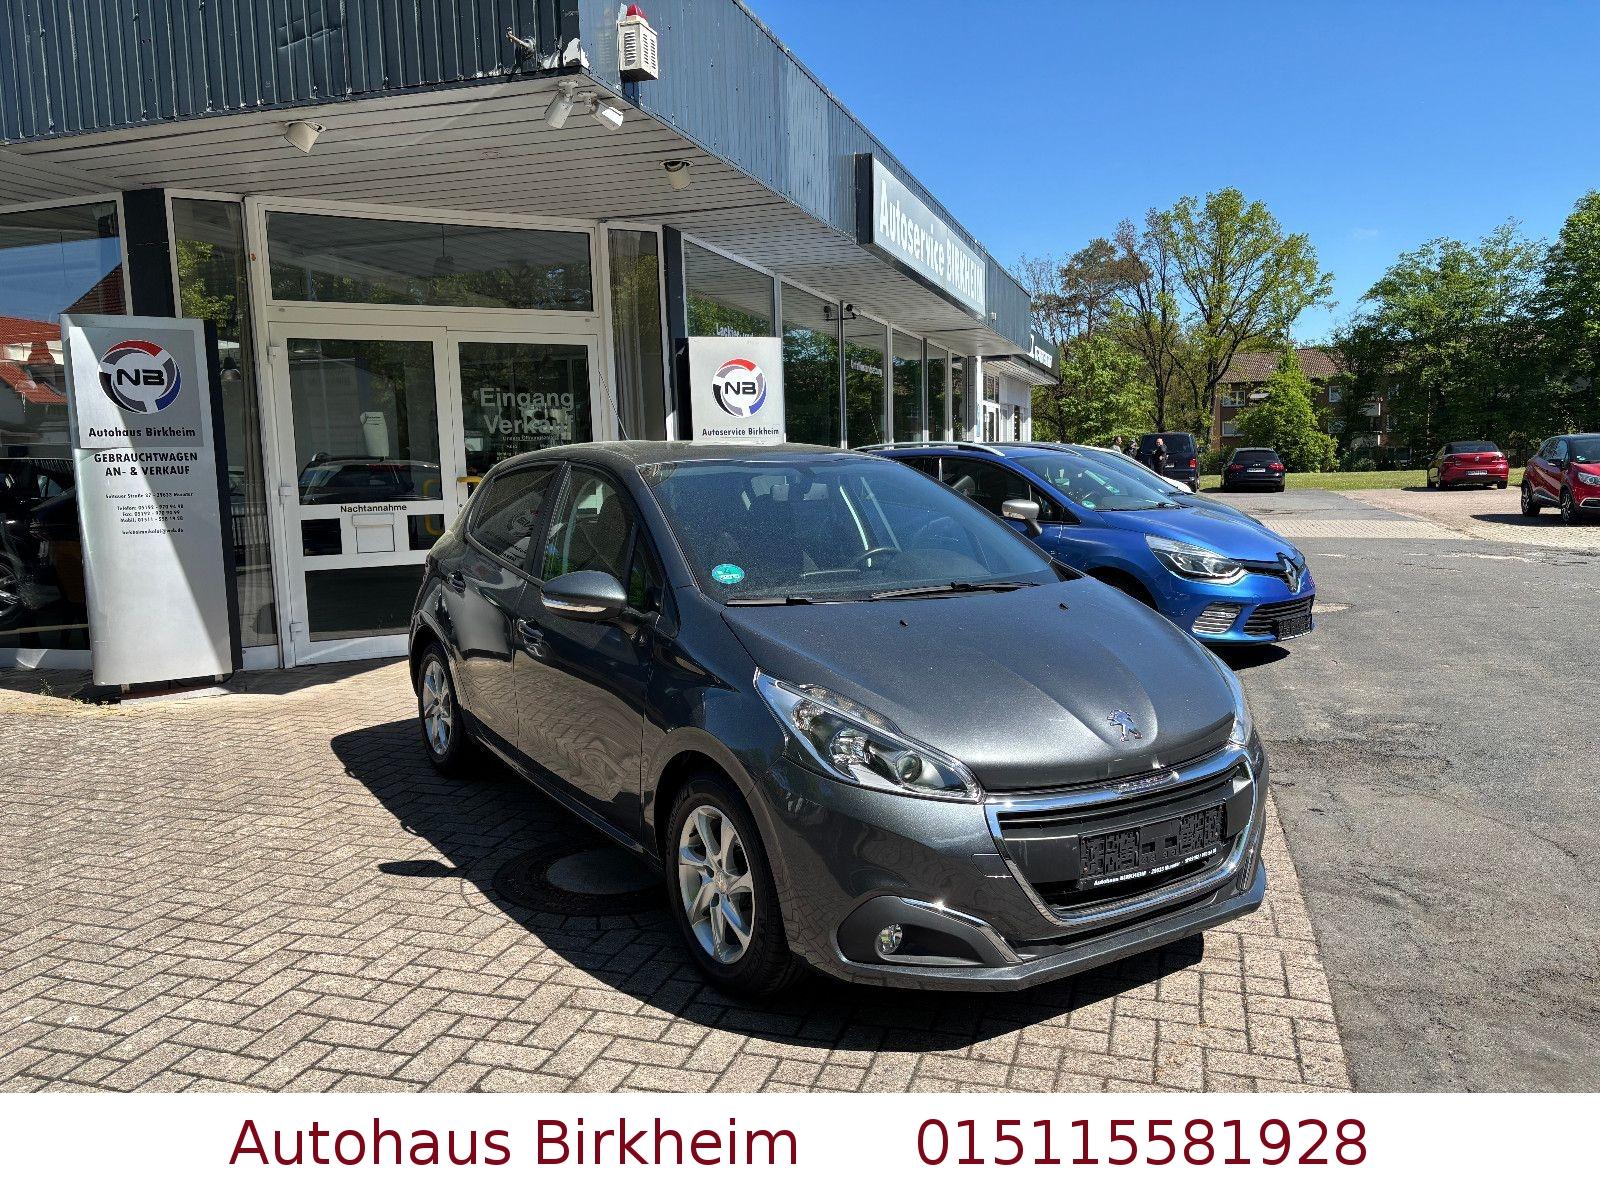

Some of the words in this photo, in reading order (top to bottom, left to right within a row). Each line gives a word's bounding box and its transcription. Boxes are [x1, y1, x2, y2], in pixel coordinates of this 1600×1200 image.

[879, 178, 945, 277] Autoservice
[116, 368, 164, 386] NB
[724, 381, 757, 396] NB
[480, 387, 575, 412] Eingang
[88, 427, 142, 437] Autohaus
[145, 427, 196, 437] Birkheim
[702, 427, 746, 436] Autoservice
[748, 427, 780, 436] Birkheim
[94, 452, 198, 462] GEBRAUCHTWAGEN
[105, 467, 126, 476] AN-
[130, 466, 138, 476] &
[141, 465, 190, 476] VERKAUF
[340, 504, 408, 513] Nachtannahme
